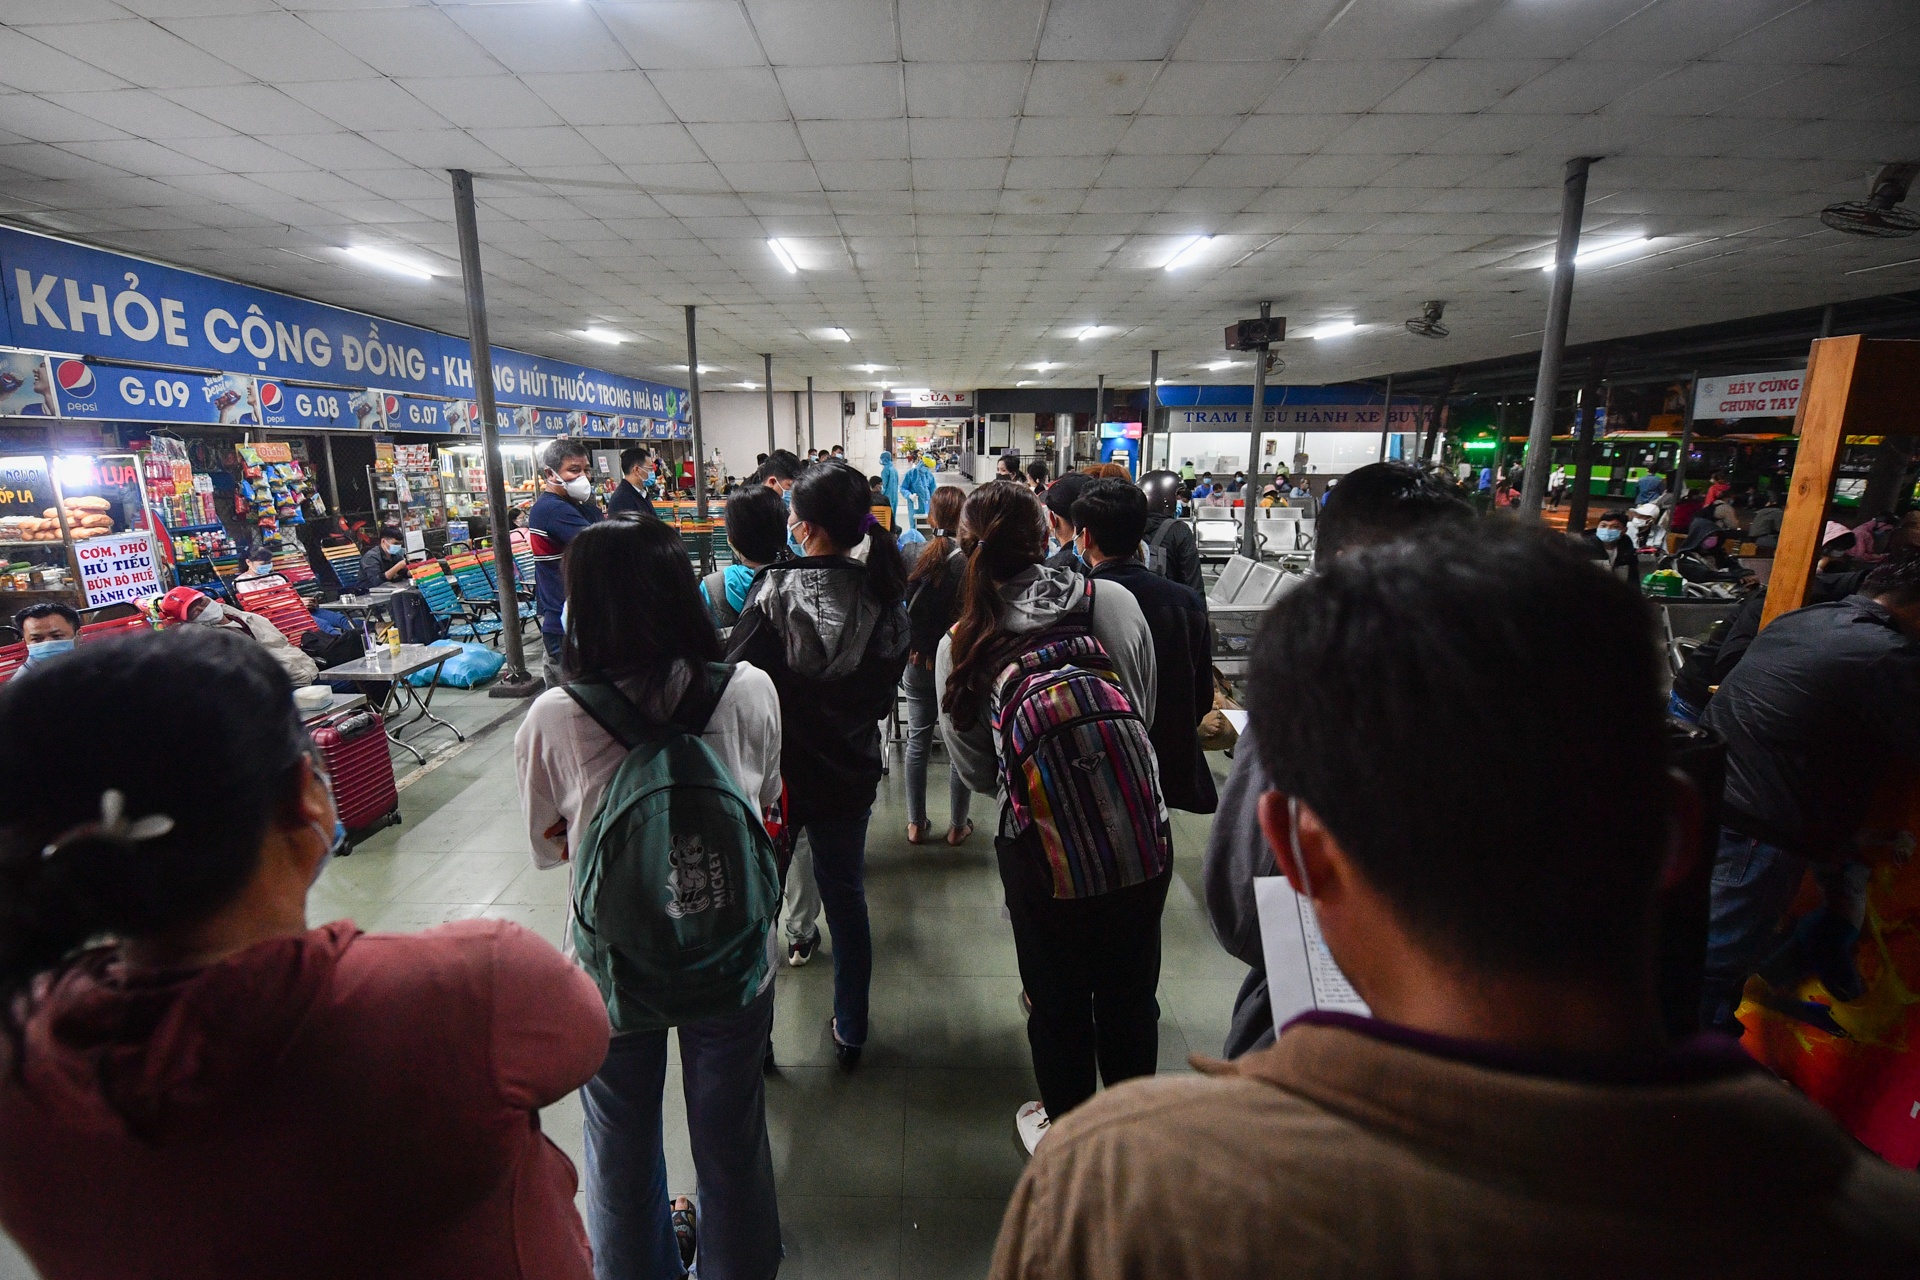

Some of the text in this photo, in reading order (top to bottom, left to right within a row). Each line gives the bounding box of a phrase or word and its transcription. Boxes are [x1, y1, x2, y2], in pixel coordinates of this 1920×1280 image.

[15, 268, 188, 347] KHỎE
[203, 304, 331, 370] CỘNG
[342, 322, 426, 381] ĐỒNG
[443, 355, 514, 393] KHNG
[519, 365, 547, 397] HÚT
[551, 371, 595, 403] THUỐC
[597, 384, 631, 408] TRONG
[633, 388, 651, 410] NHÀ
[652, 394, 664, 412] GA
[119, 377, 189, 408] G.09
[955, 394, 965, 402] E
[67, 402, 98, 413] pepsi
[295, 394, 340, 419] G.08
[1719, 397, 1799, 412] CHUNG TAY
[266, 415, 286, 424] pepsi
[409, 404, 437, 425] G.07
[497, 411, 509, 428] 06
[545, 416, 563, 430] G.05
[1183, 411, 1238, 425] TRẠM
[1294, 407, 1348, 423] HÀNH
[1355, 411, 1380, 423] XE
[260, 446, 285, 457] Oishi
[16, 490, 34, 503] LA
[80, 539, 148, 560] CƠM, PHỞ
[84, 554, 150, 576] HỦ TIẾU
[87, 566, 155, 590] BÚN BÒ HUẾ
[90, 584, 158, 605] BÁNH CANH
